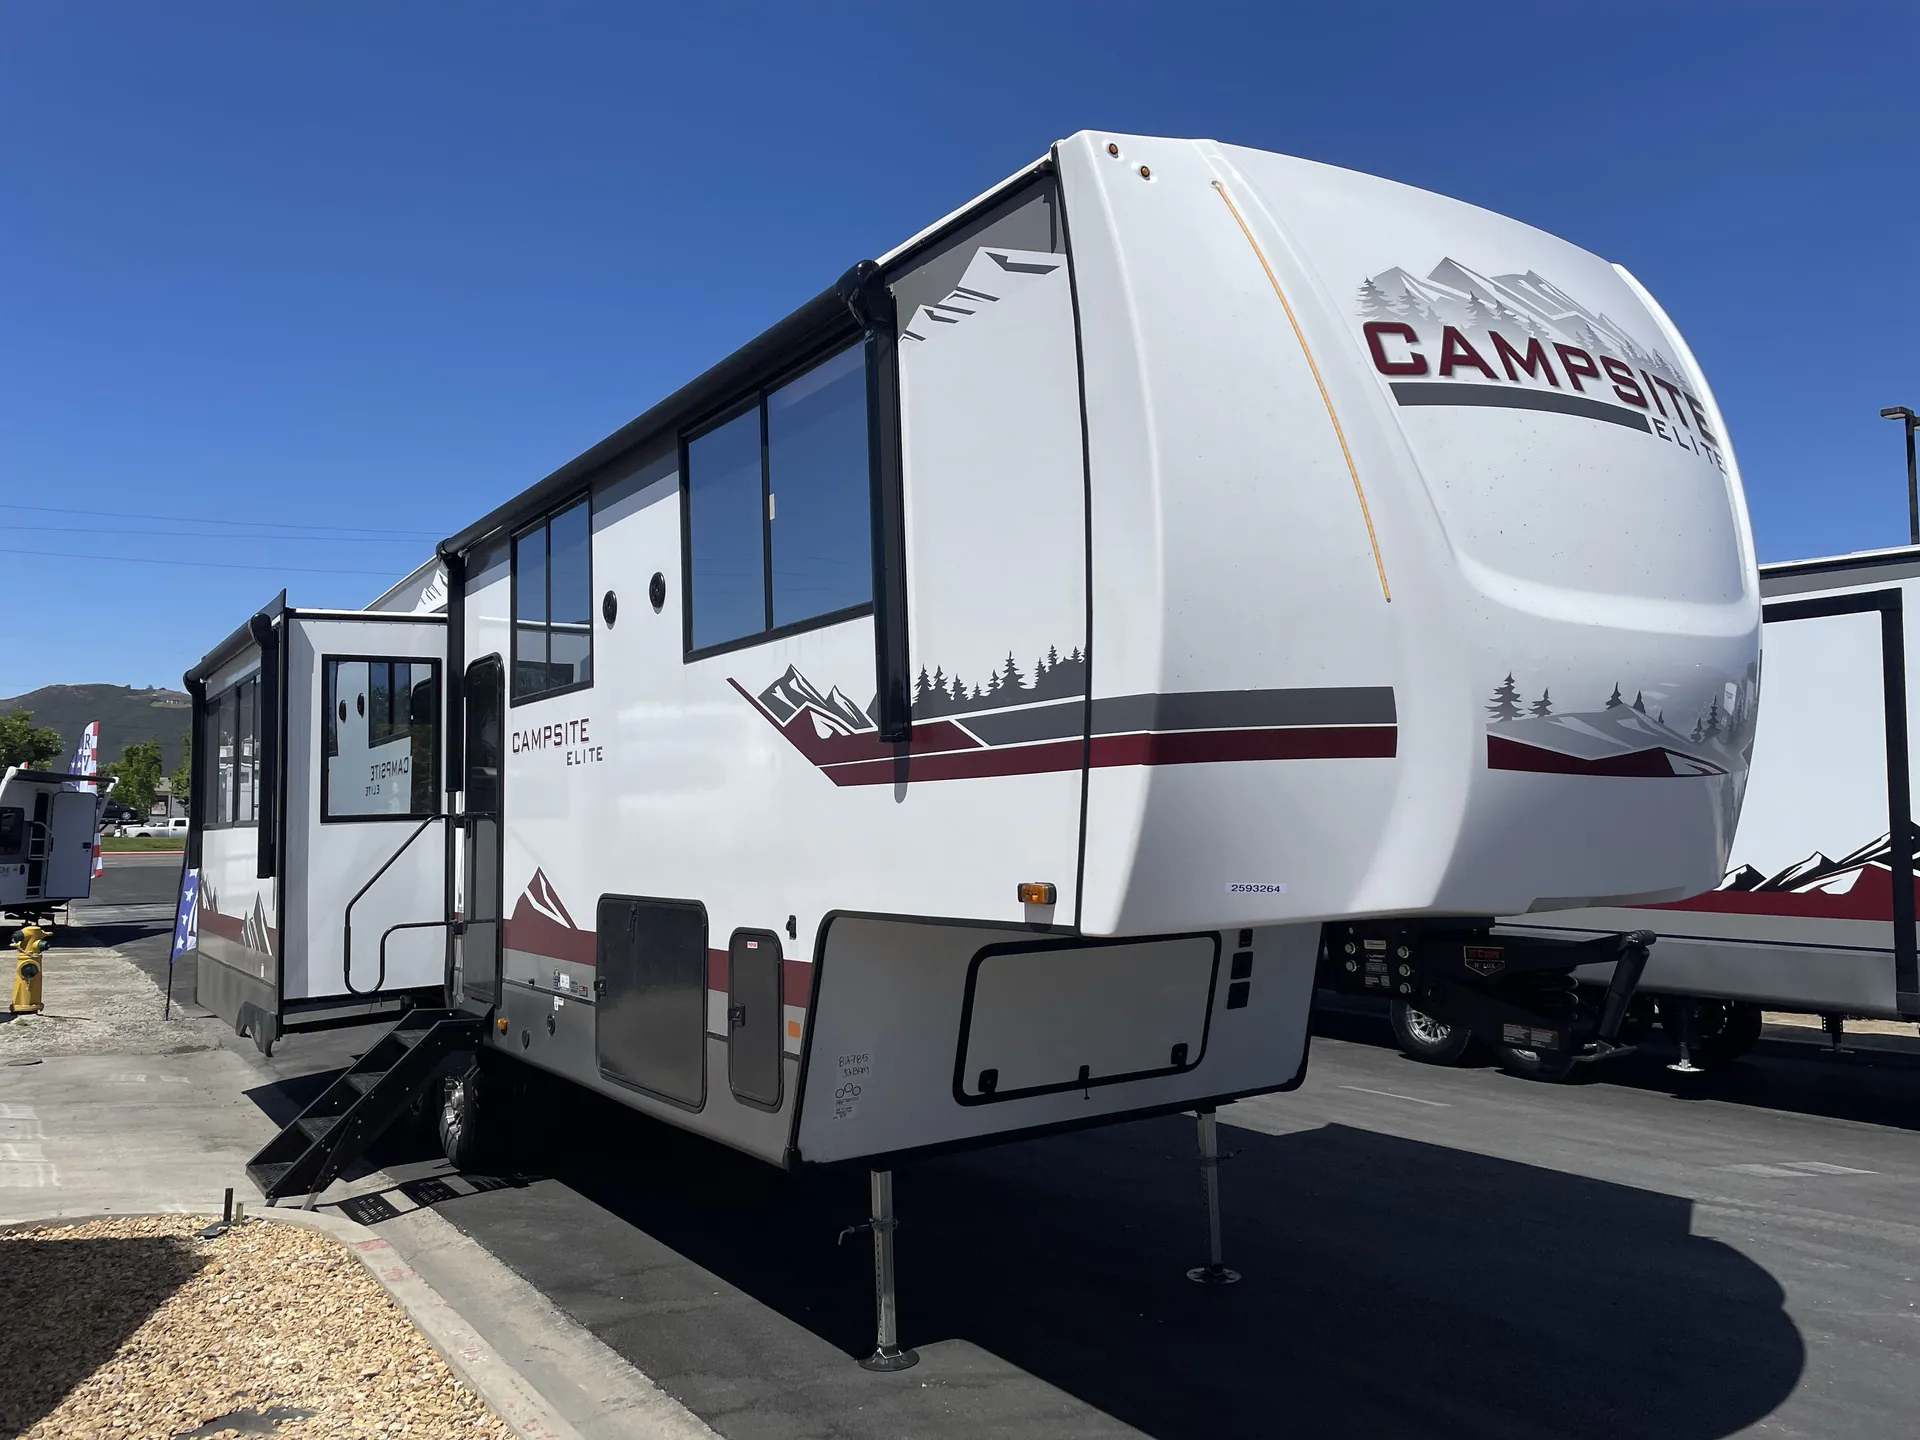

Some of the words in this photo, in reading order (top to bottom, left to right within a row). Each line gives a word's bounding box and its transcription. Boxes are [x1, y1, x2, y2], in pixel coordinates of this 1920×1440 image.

[1363, 321, 1719, 445] CAMPSITE
[1652, 417, 1727, 475] ELITE
[512, 717, 590, 754] CAMPSITE
[566, 746, 603, 766] ELITE
[1230, 883, 1281, 893] 2593264
